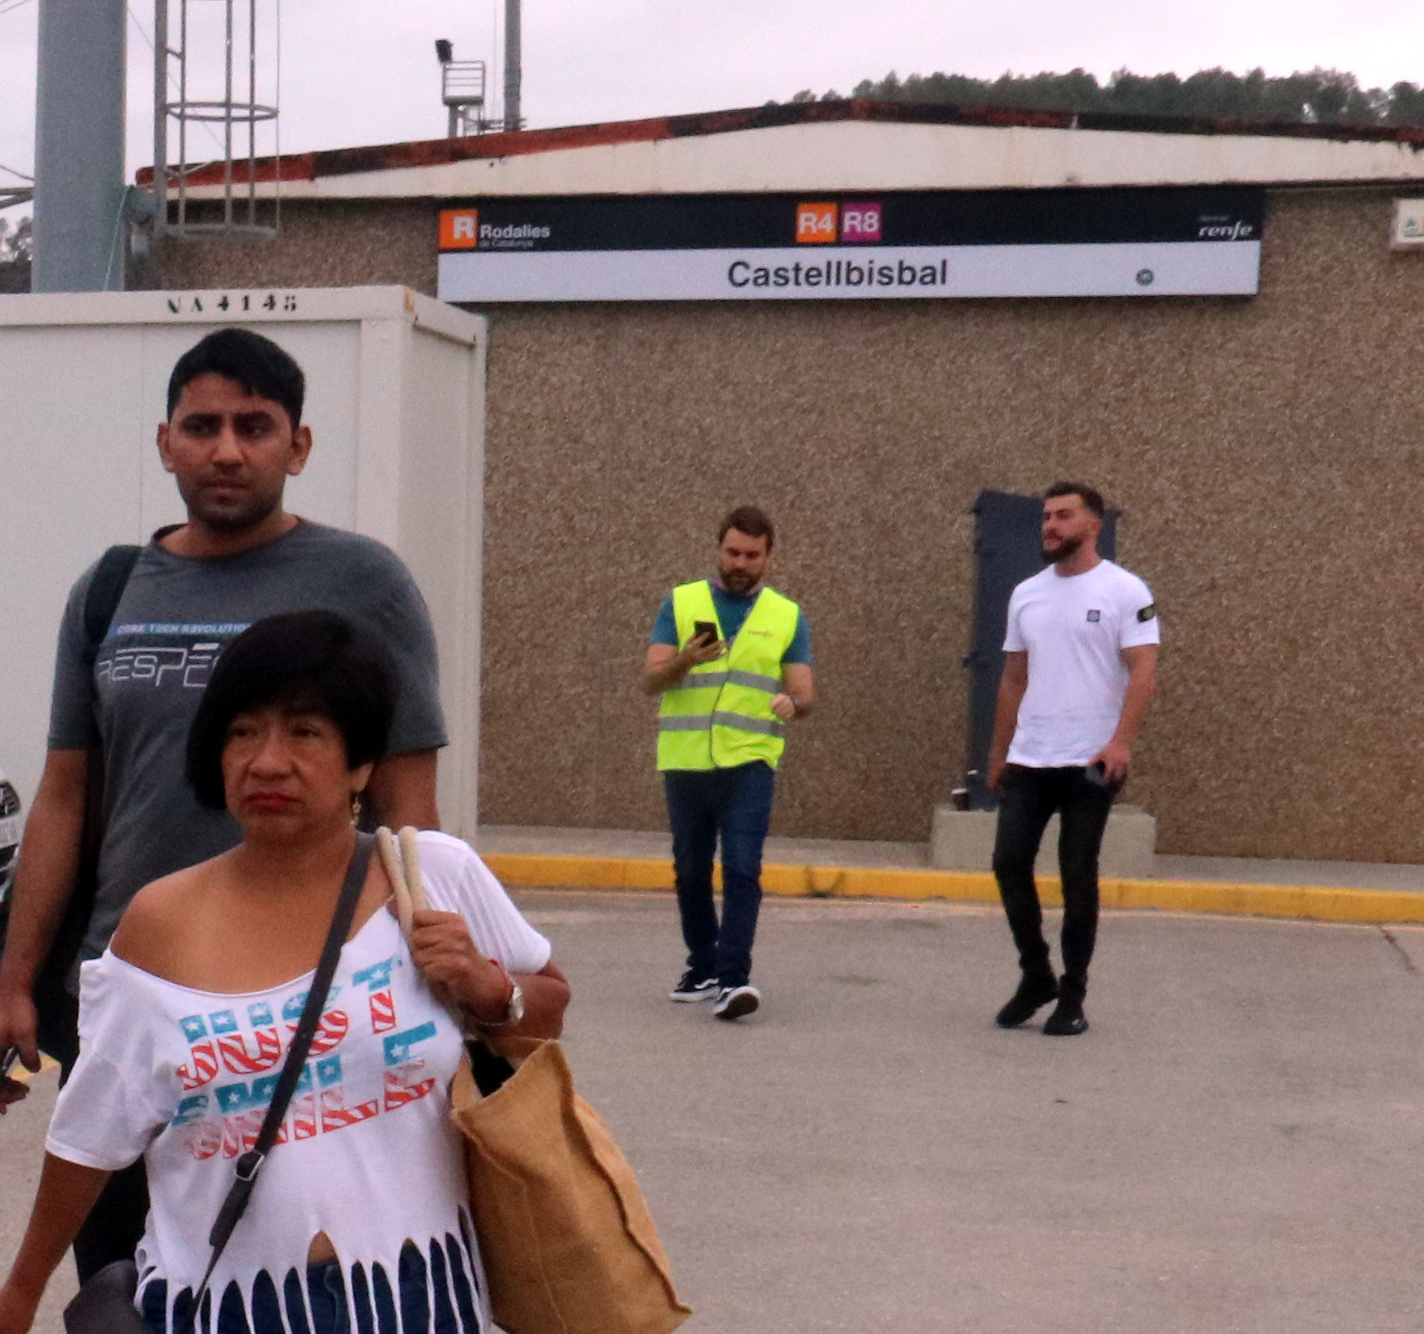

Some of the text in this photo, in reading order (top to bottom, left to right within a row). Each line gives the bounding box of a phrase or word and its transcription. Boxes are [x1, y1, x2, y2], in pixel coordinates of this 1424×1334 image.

[453, 216, 475, 239] R
[480, 224, 550, 238] Rodalies
[799, 210, 879, 233] R4 R8
[1198, 221, 1252, 241] renfe
[727, 259, 948, 287] Castellbisbal
[182, 623, 251, 635] REVOLUTIO
[176, 956, 402, 1091] JUST
